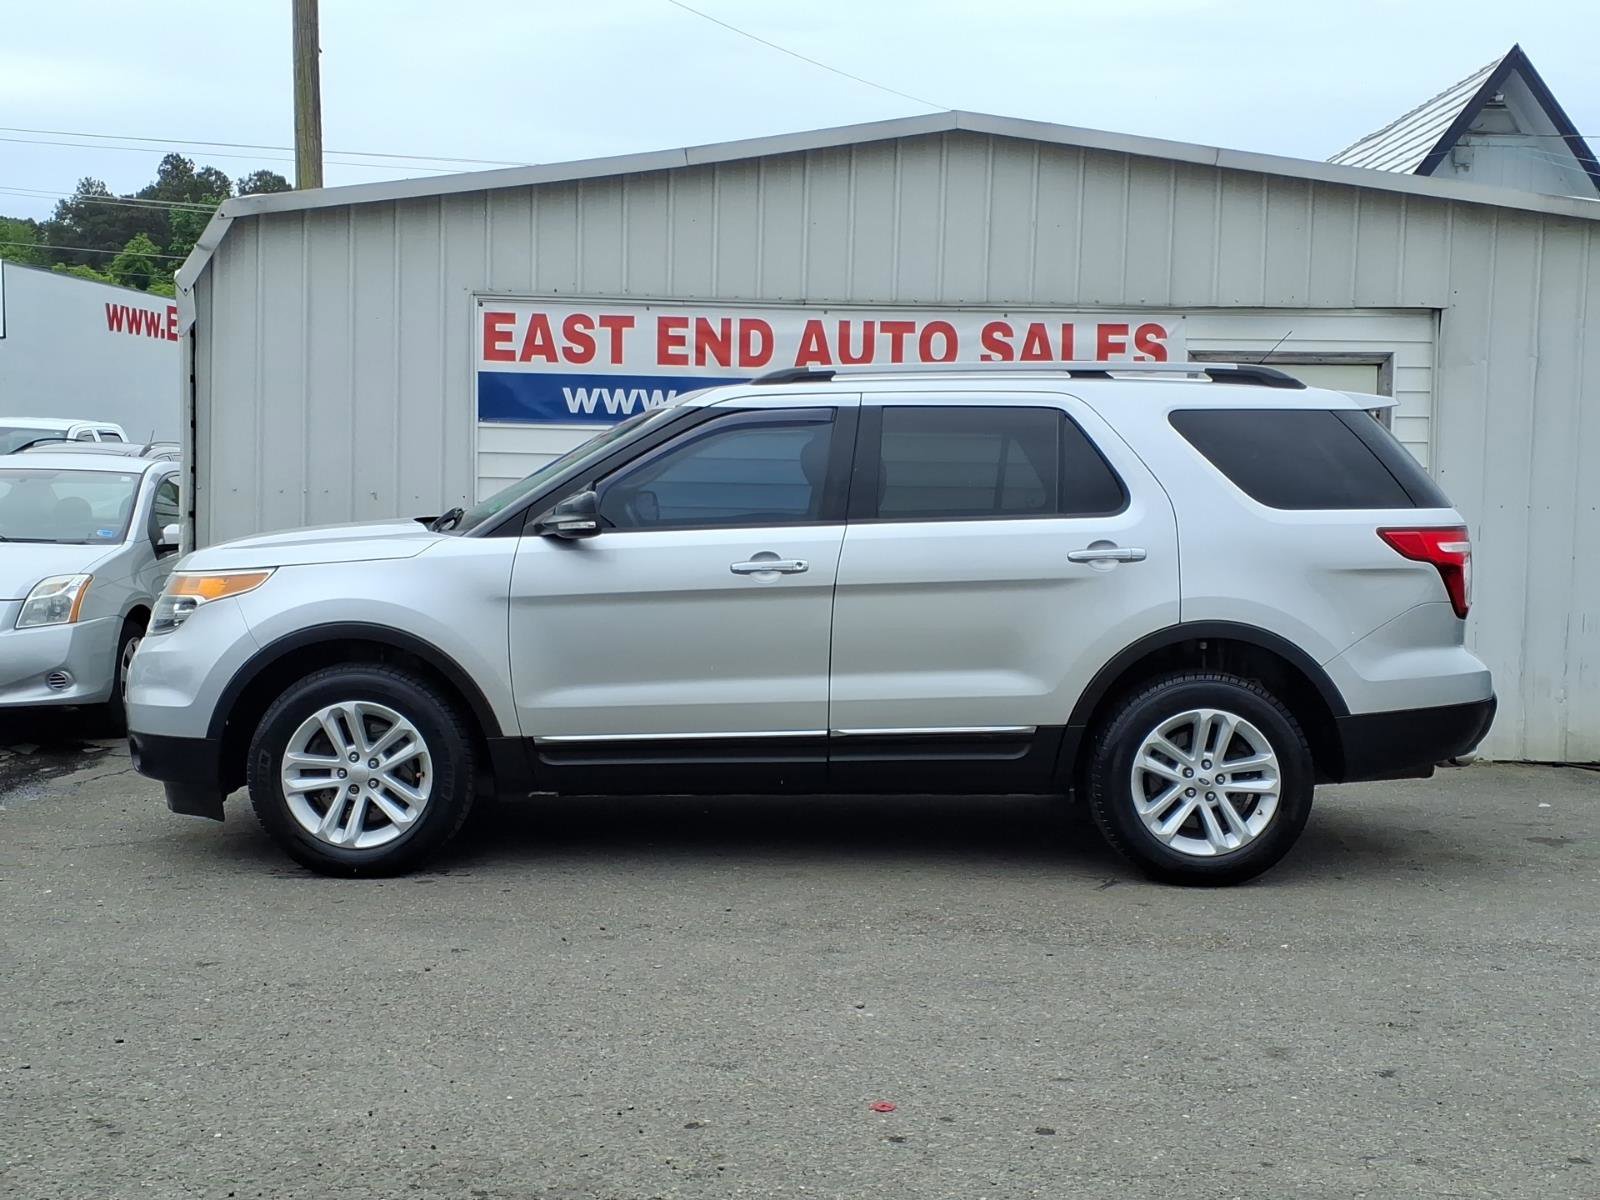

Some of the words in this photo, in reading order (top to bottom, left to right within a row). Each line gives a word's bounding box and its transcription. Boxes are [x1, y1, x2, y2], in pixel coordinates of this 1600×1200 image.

[483, 312, 635, 365] EAST
[657, 316, 775, 368] END
[794, 319, 960, 368] AUTO
[980, 322, 1168, 363] SALES
